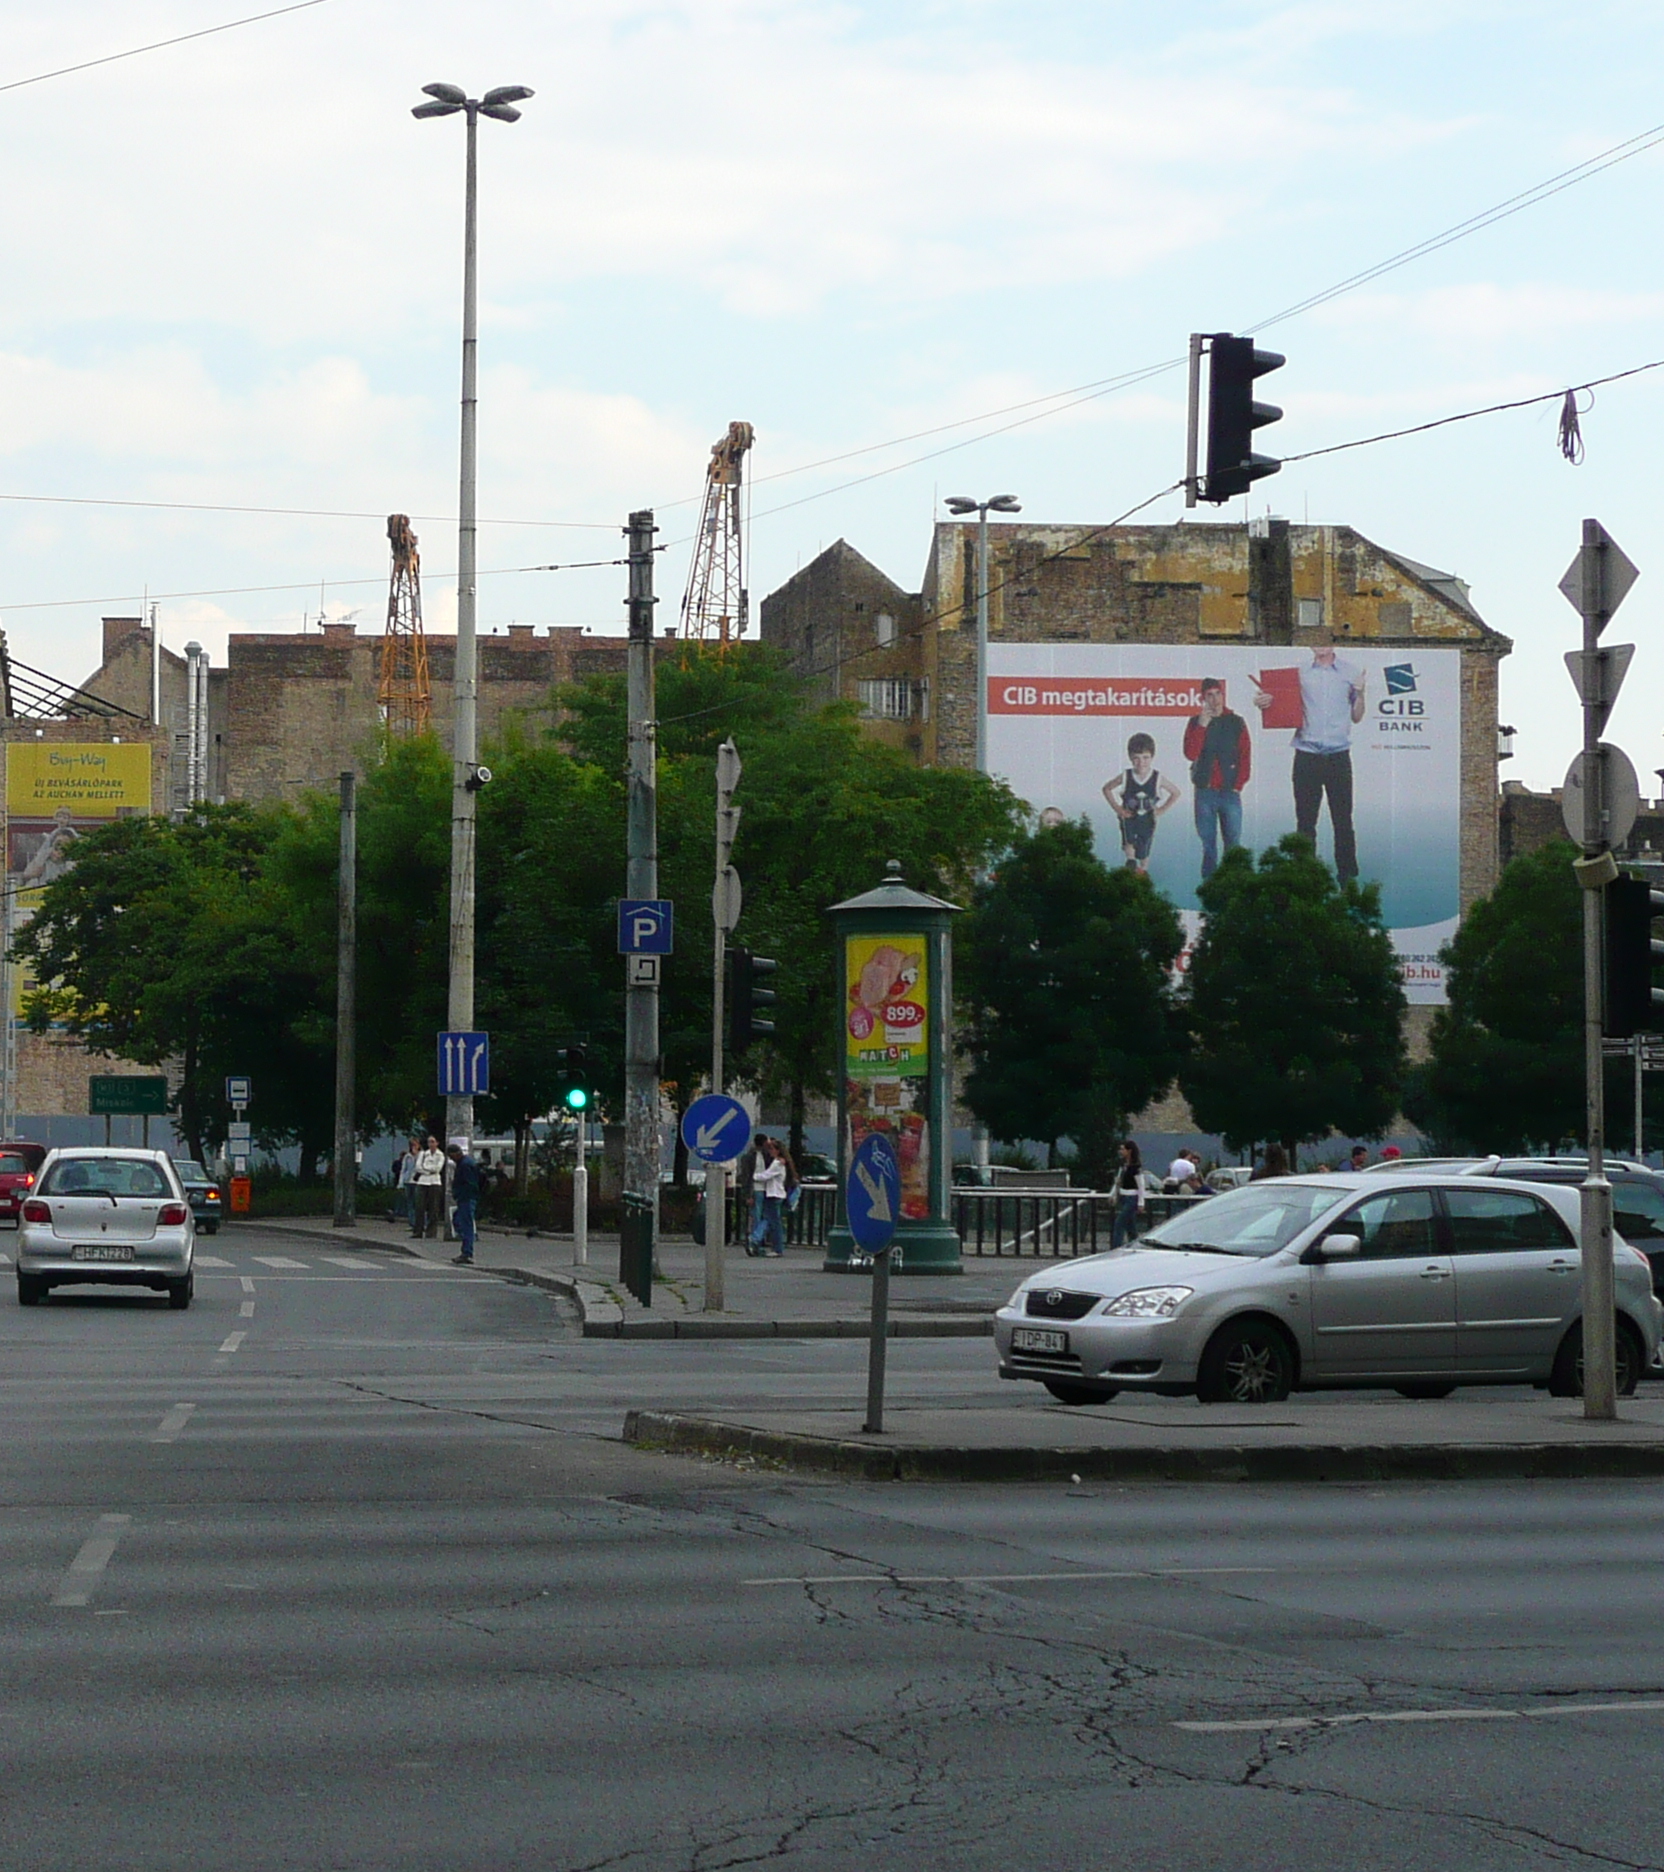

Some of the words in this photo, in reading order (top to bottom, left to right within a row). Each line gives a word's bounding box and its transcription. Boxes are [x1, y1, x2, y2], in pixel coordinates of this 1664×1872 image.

[1003, 686, 1037, 705] CIB
[1041, 686, 1203, 710] megtakarítások
[1378, 699, 1424, 715] CIB
[1379, 721, 1423, 732] BANK
[47, 790, 84, 799] AUCHAN
[87, 790, 125, 799] MELLETT
[633, 917, 657, 948] P
[1402, 965, 1441, 979] ib.hu
